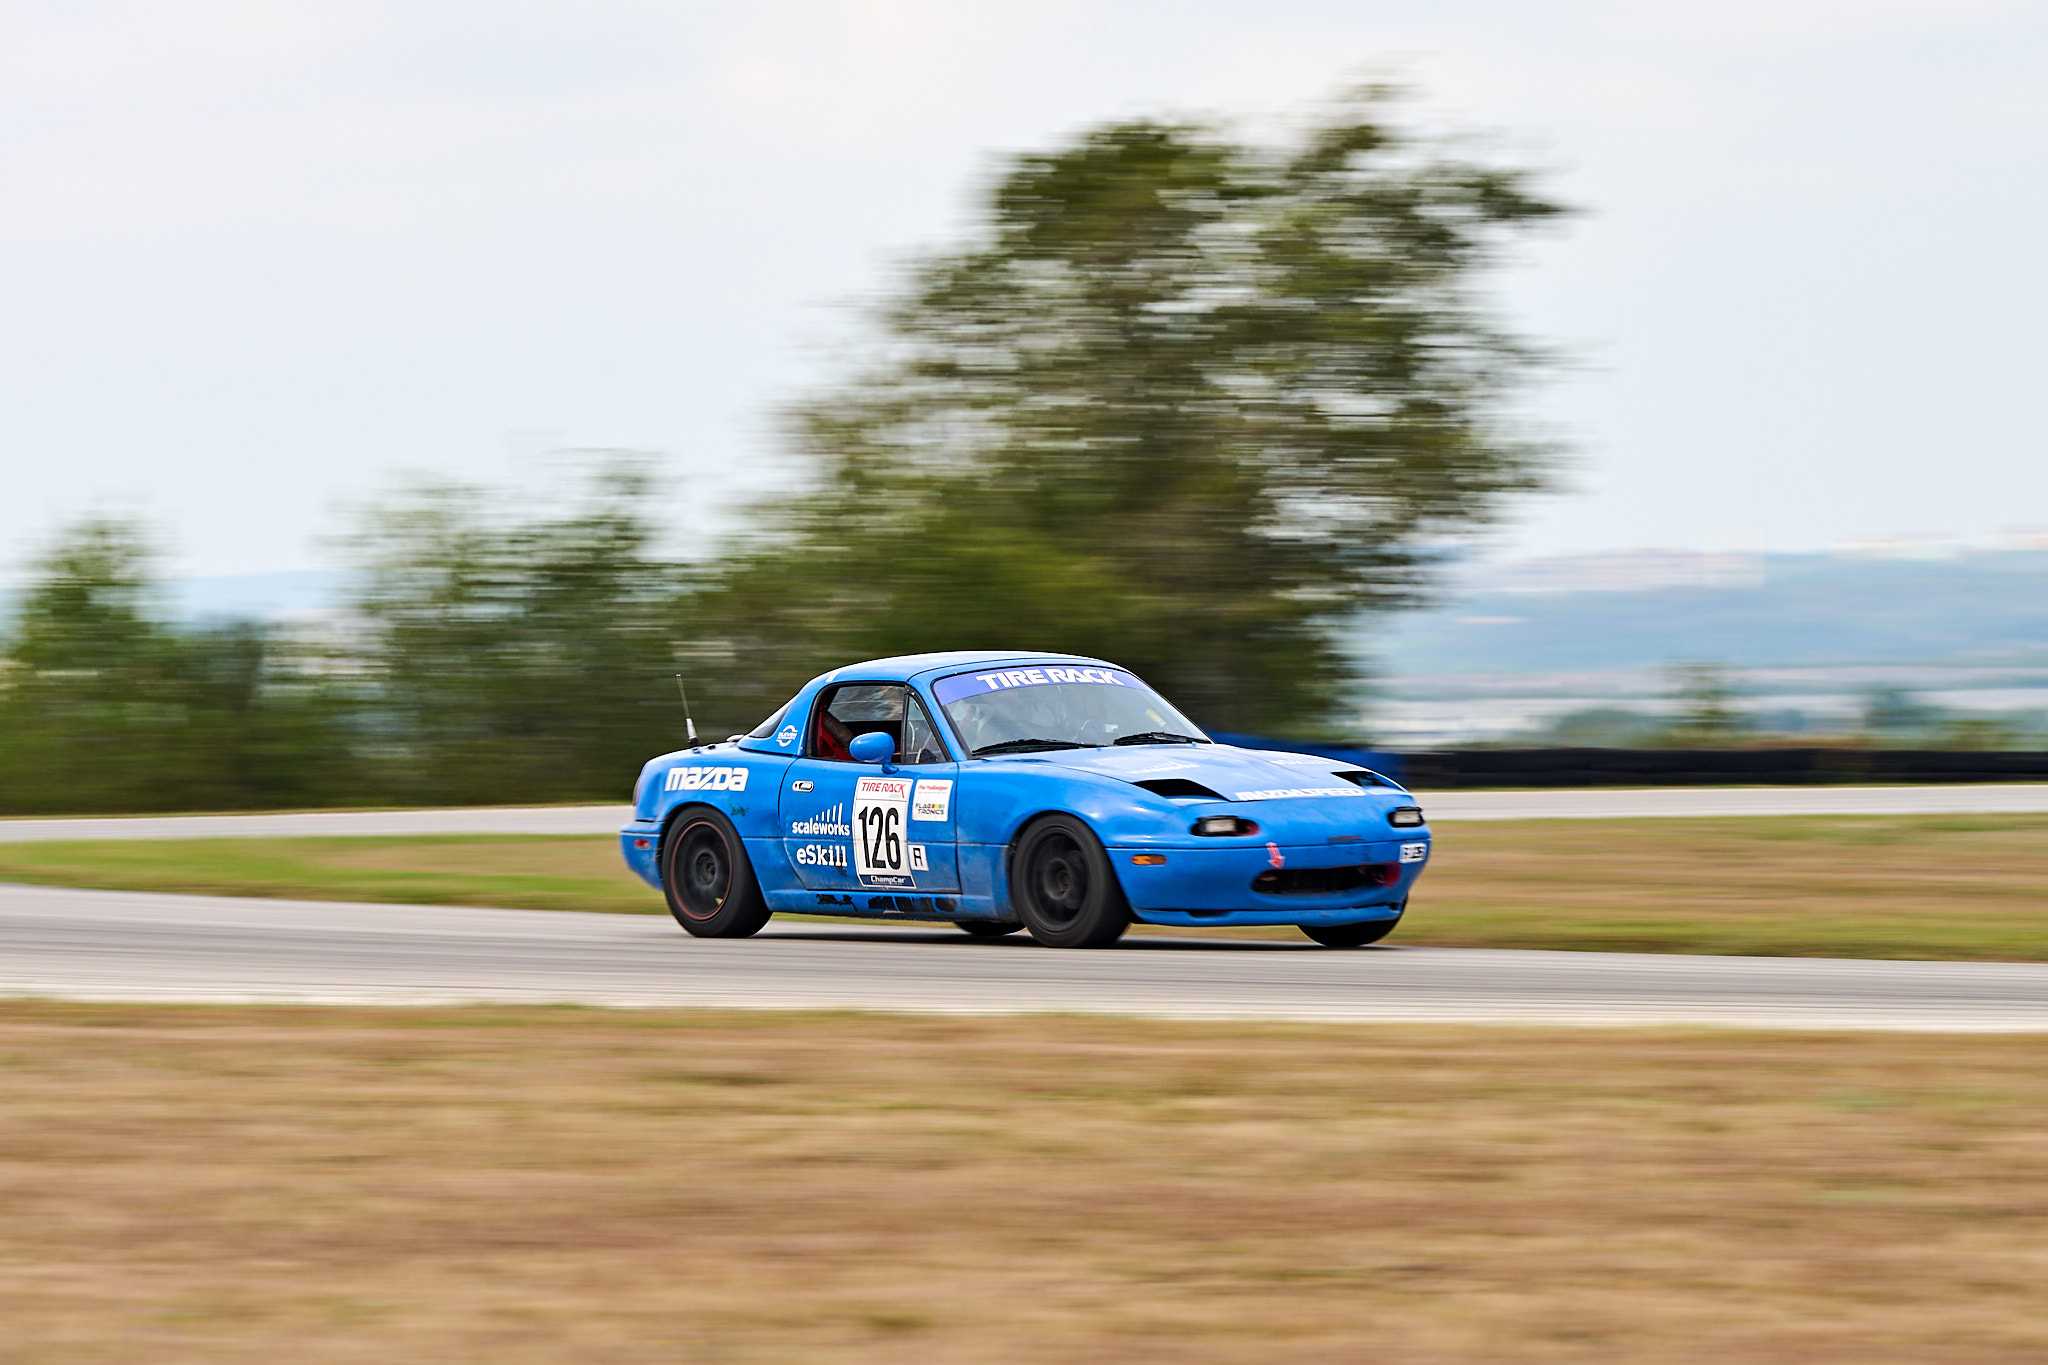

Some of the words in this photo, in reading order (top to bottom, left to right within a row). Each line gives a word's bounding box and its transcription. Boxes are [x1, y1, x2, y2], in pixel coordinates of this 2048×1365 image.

[976, 668, 1049, 690] TIRE
[1045, 668, 1125, 686] RACK
[862, 782, 882, 791] TIRE
[881, 783, 906, 798] RACK
[1235, 788, 1366, 801] MAZDASPEED
[792, 802, 851, 836] scaleworks
[858, 806, 901, 870] 126
[796, 844, 848, 867] eSkill
[871, 876, 905, 884] ChampCar
